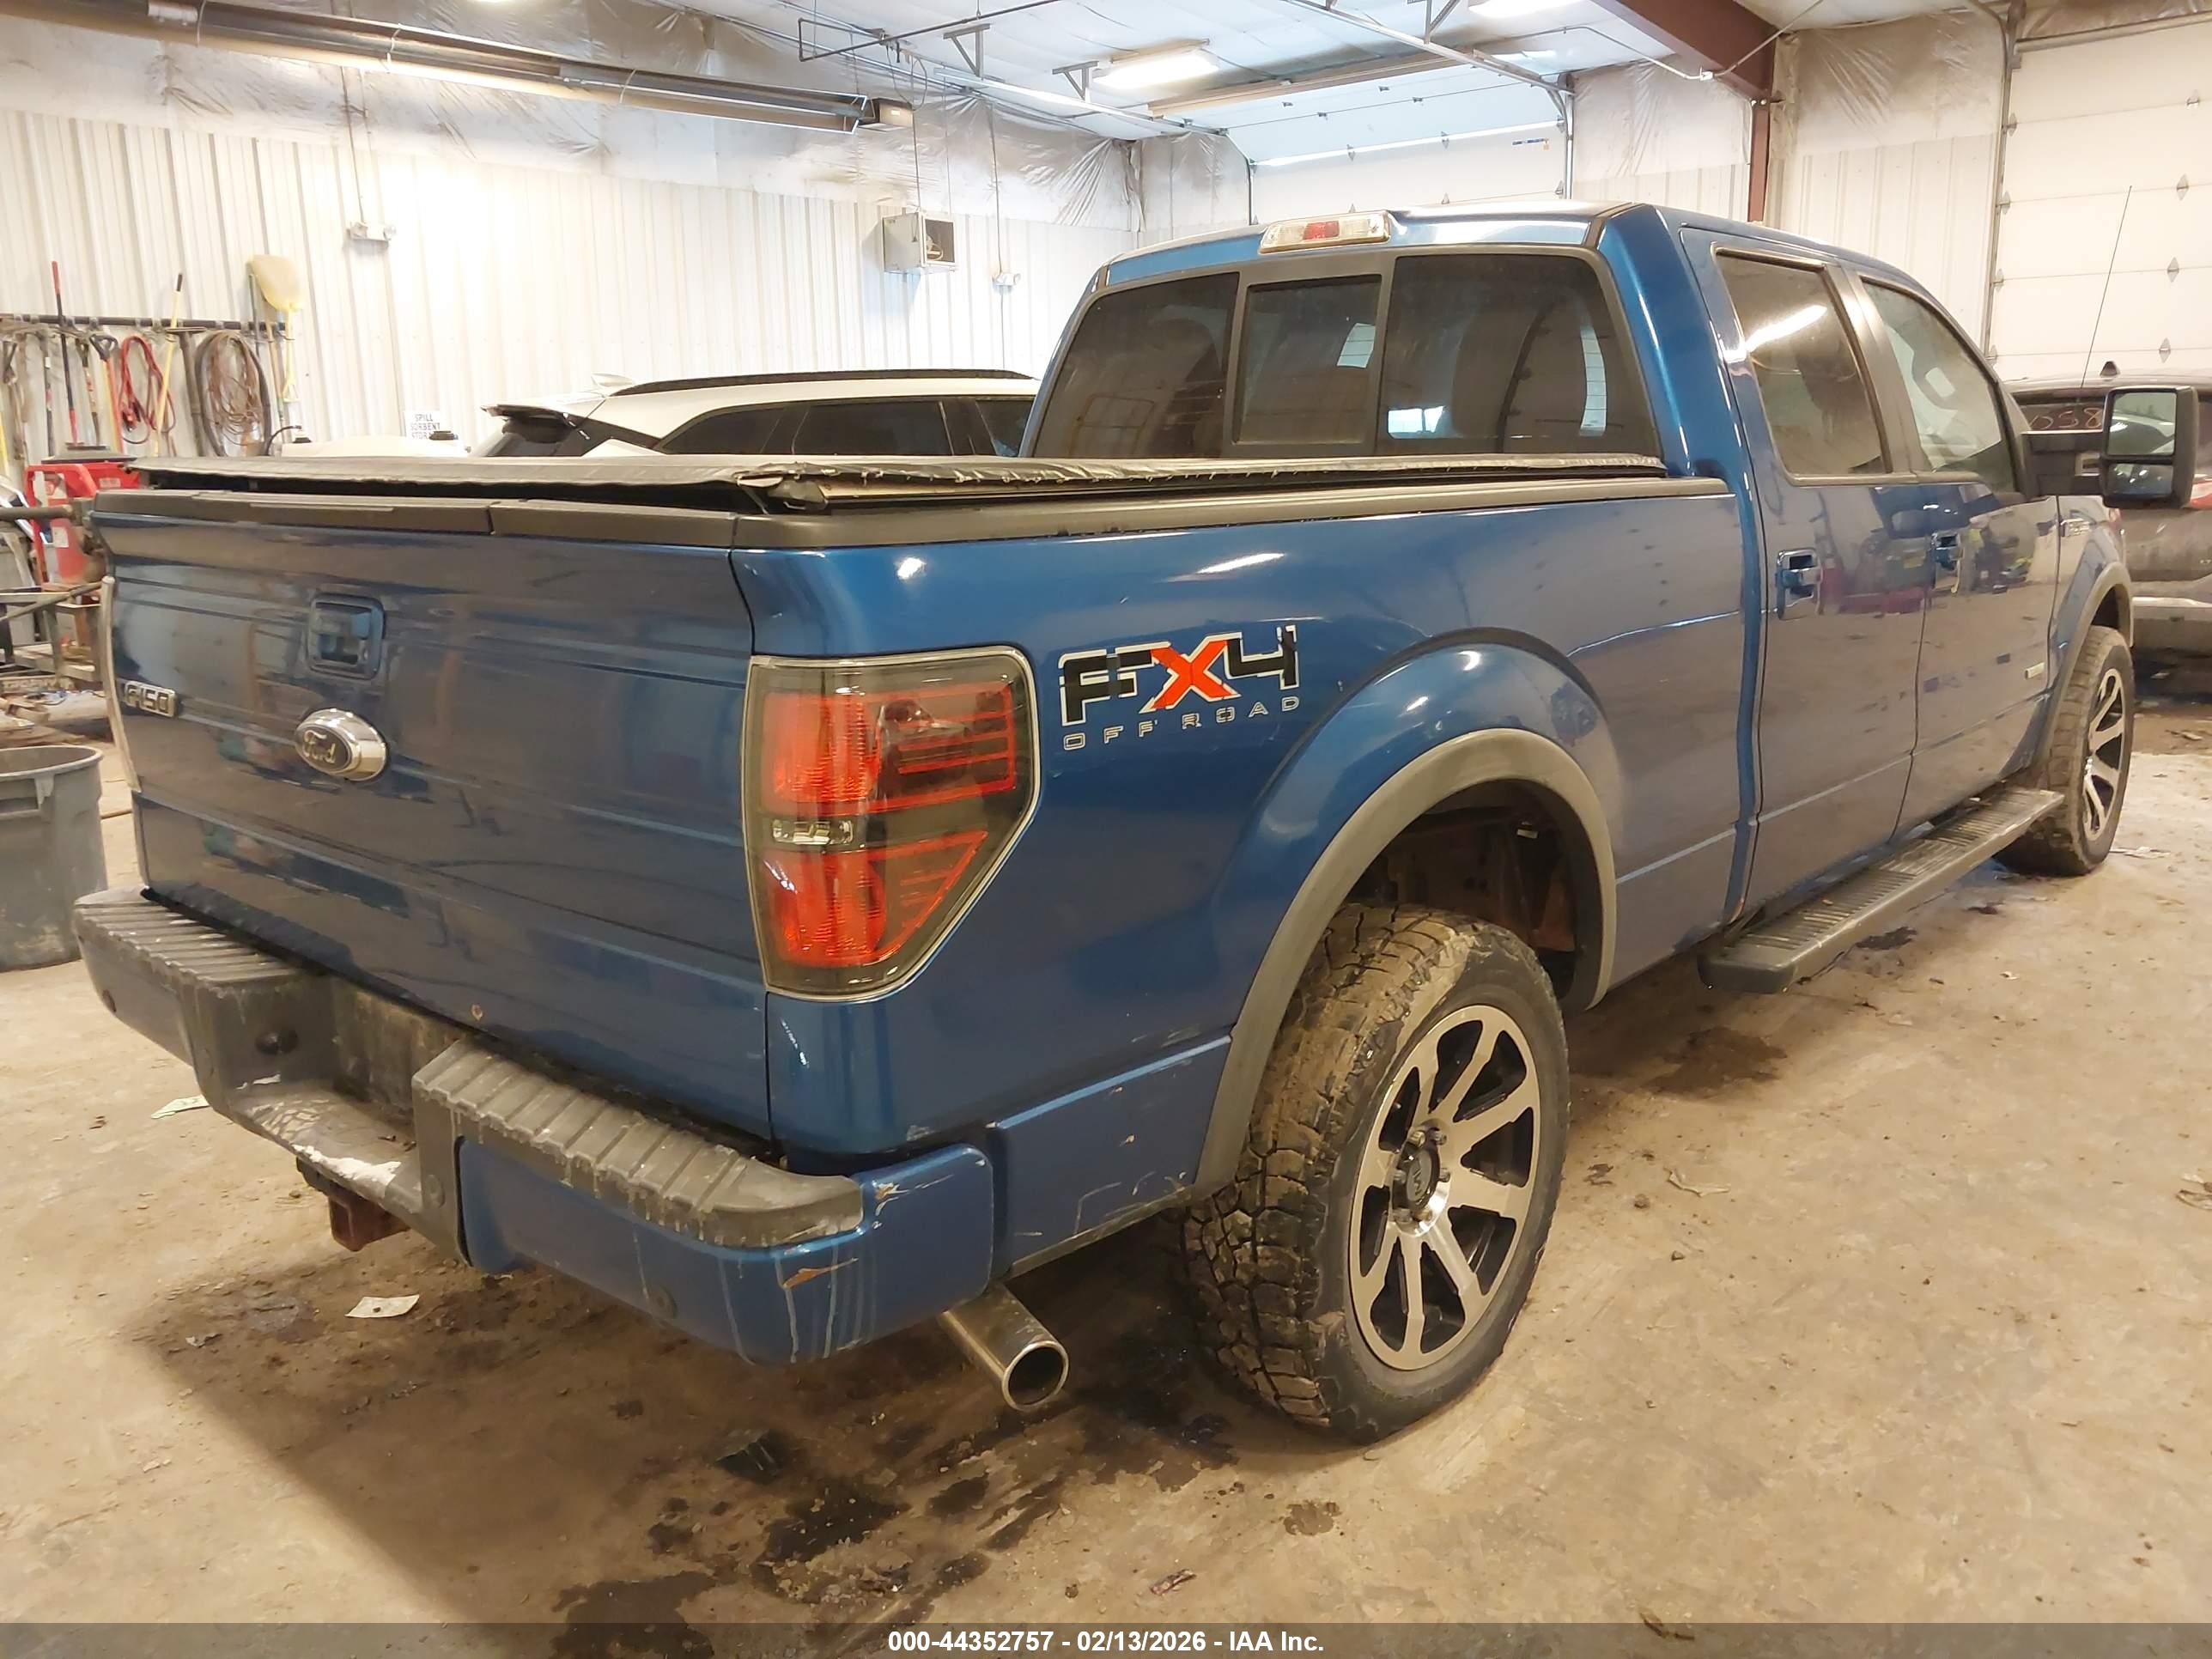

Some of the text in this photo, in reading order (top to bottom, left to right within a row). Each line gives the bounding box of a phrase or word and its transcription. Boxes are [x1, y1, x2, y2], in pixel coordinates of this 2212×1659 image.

[1064, 696, 1299, 750] OFF ROAD
[301, 730, 337, 763] Ford
